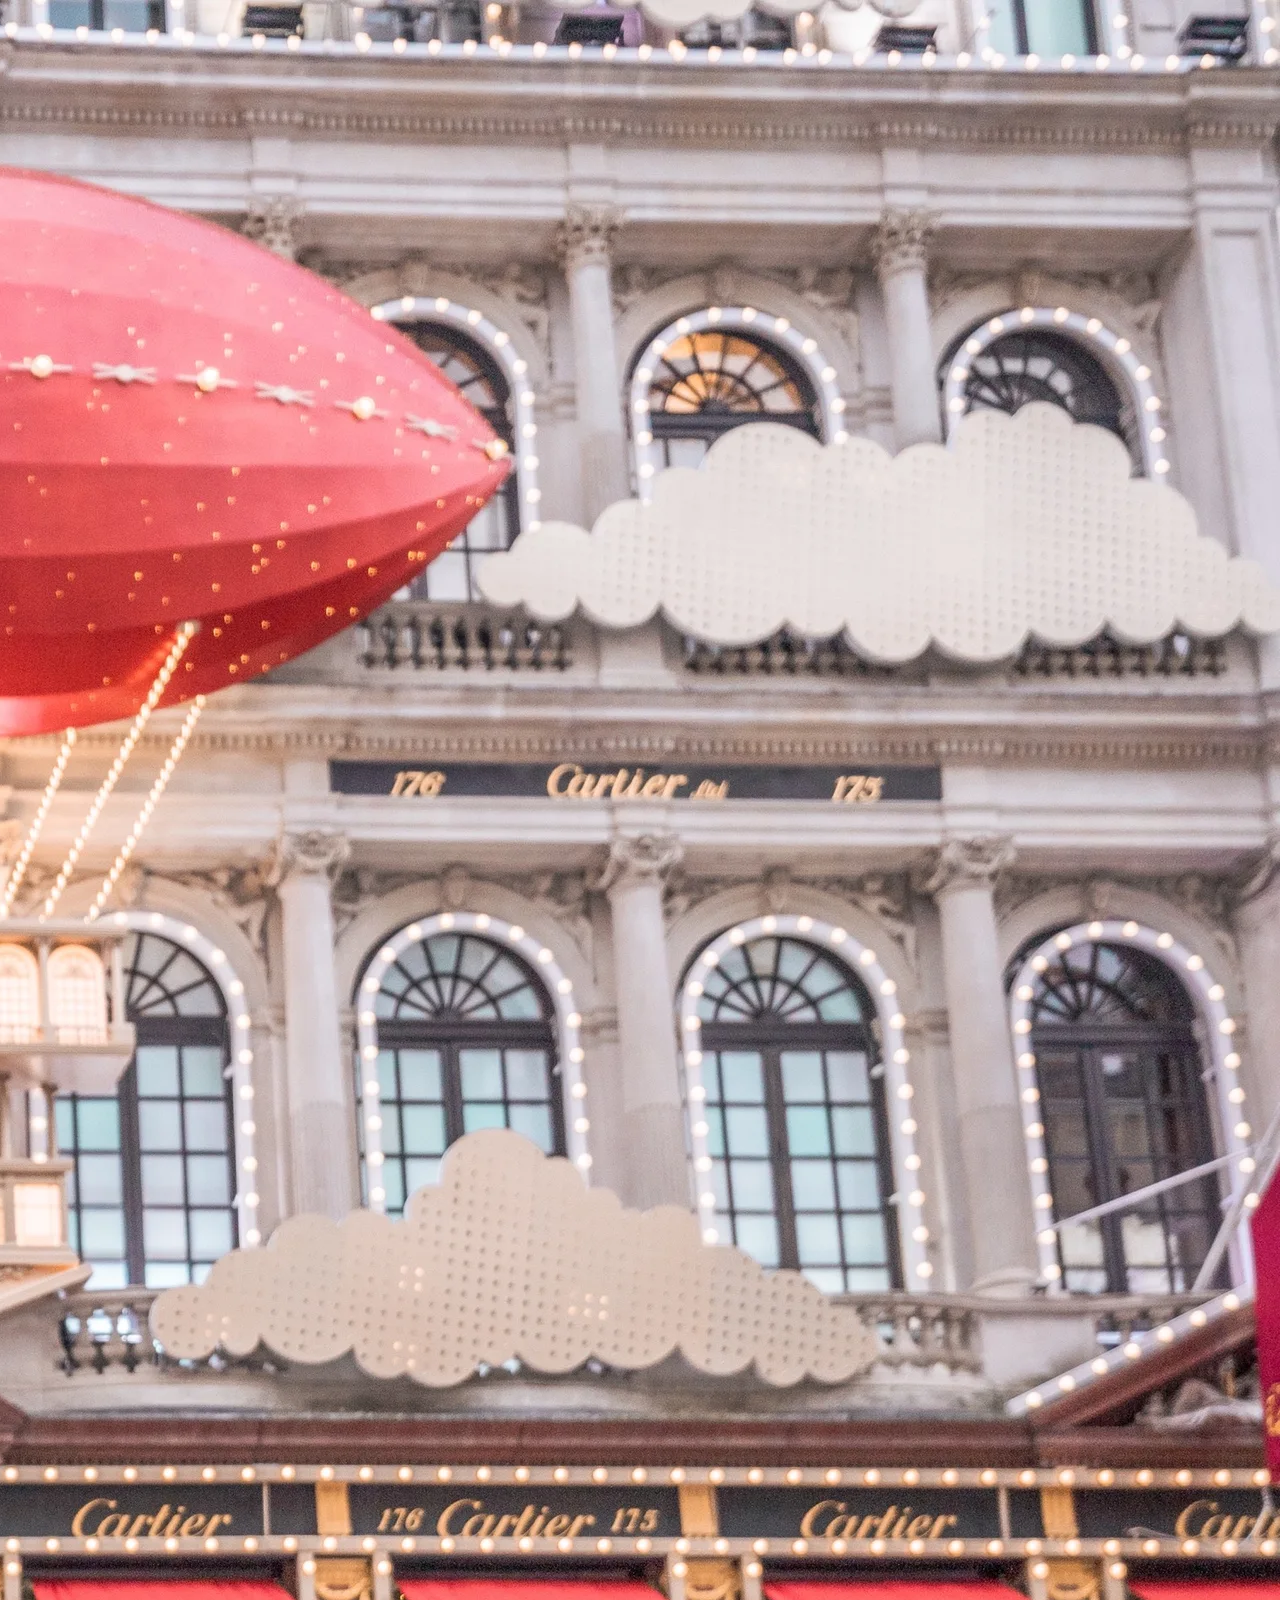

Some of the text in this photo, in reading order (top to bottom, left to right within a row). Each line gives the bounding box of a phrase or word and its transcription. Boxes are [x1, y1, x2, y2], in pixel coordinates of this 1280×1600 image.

[390, 770, 446, 798] 176
[547, 763, 688, 799] Cartier
[832, 775, 886, 802] 175
[72, 1498, 233, 1537] Cartier
[376, 1498, 660, 1537] 176 Cartier 175
[800, 1500, 958, 1538] Cartier
